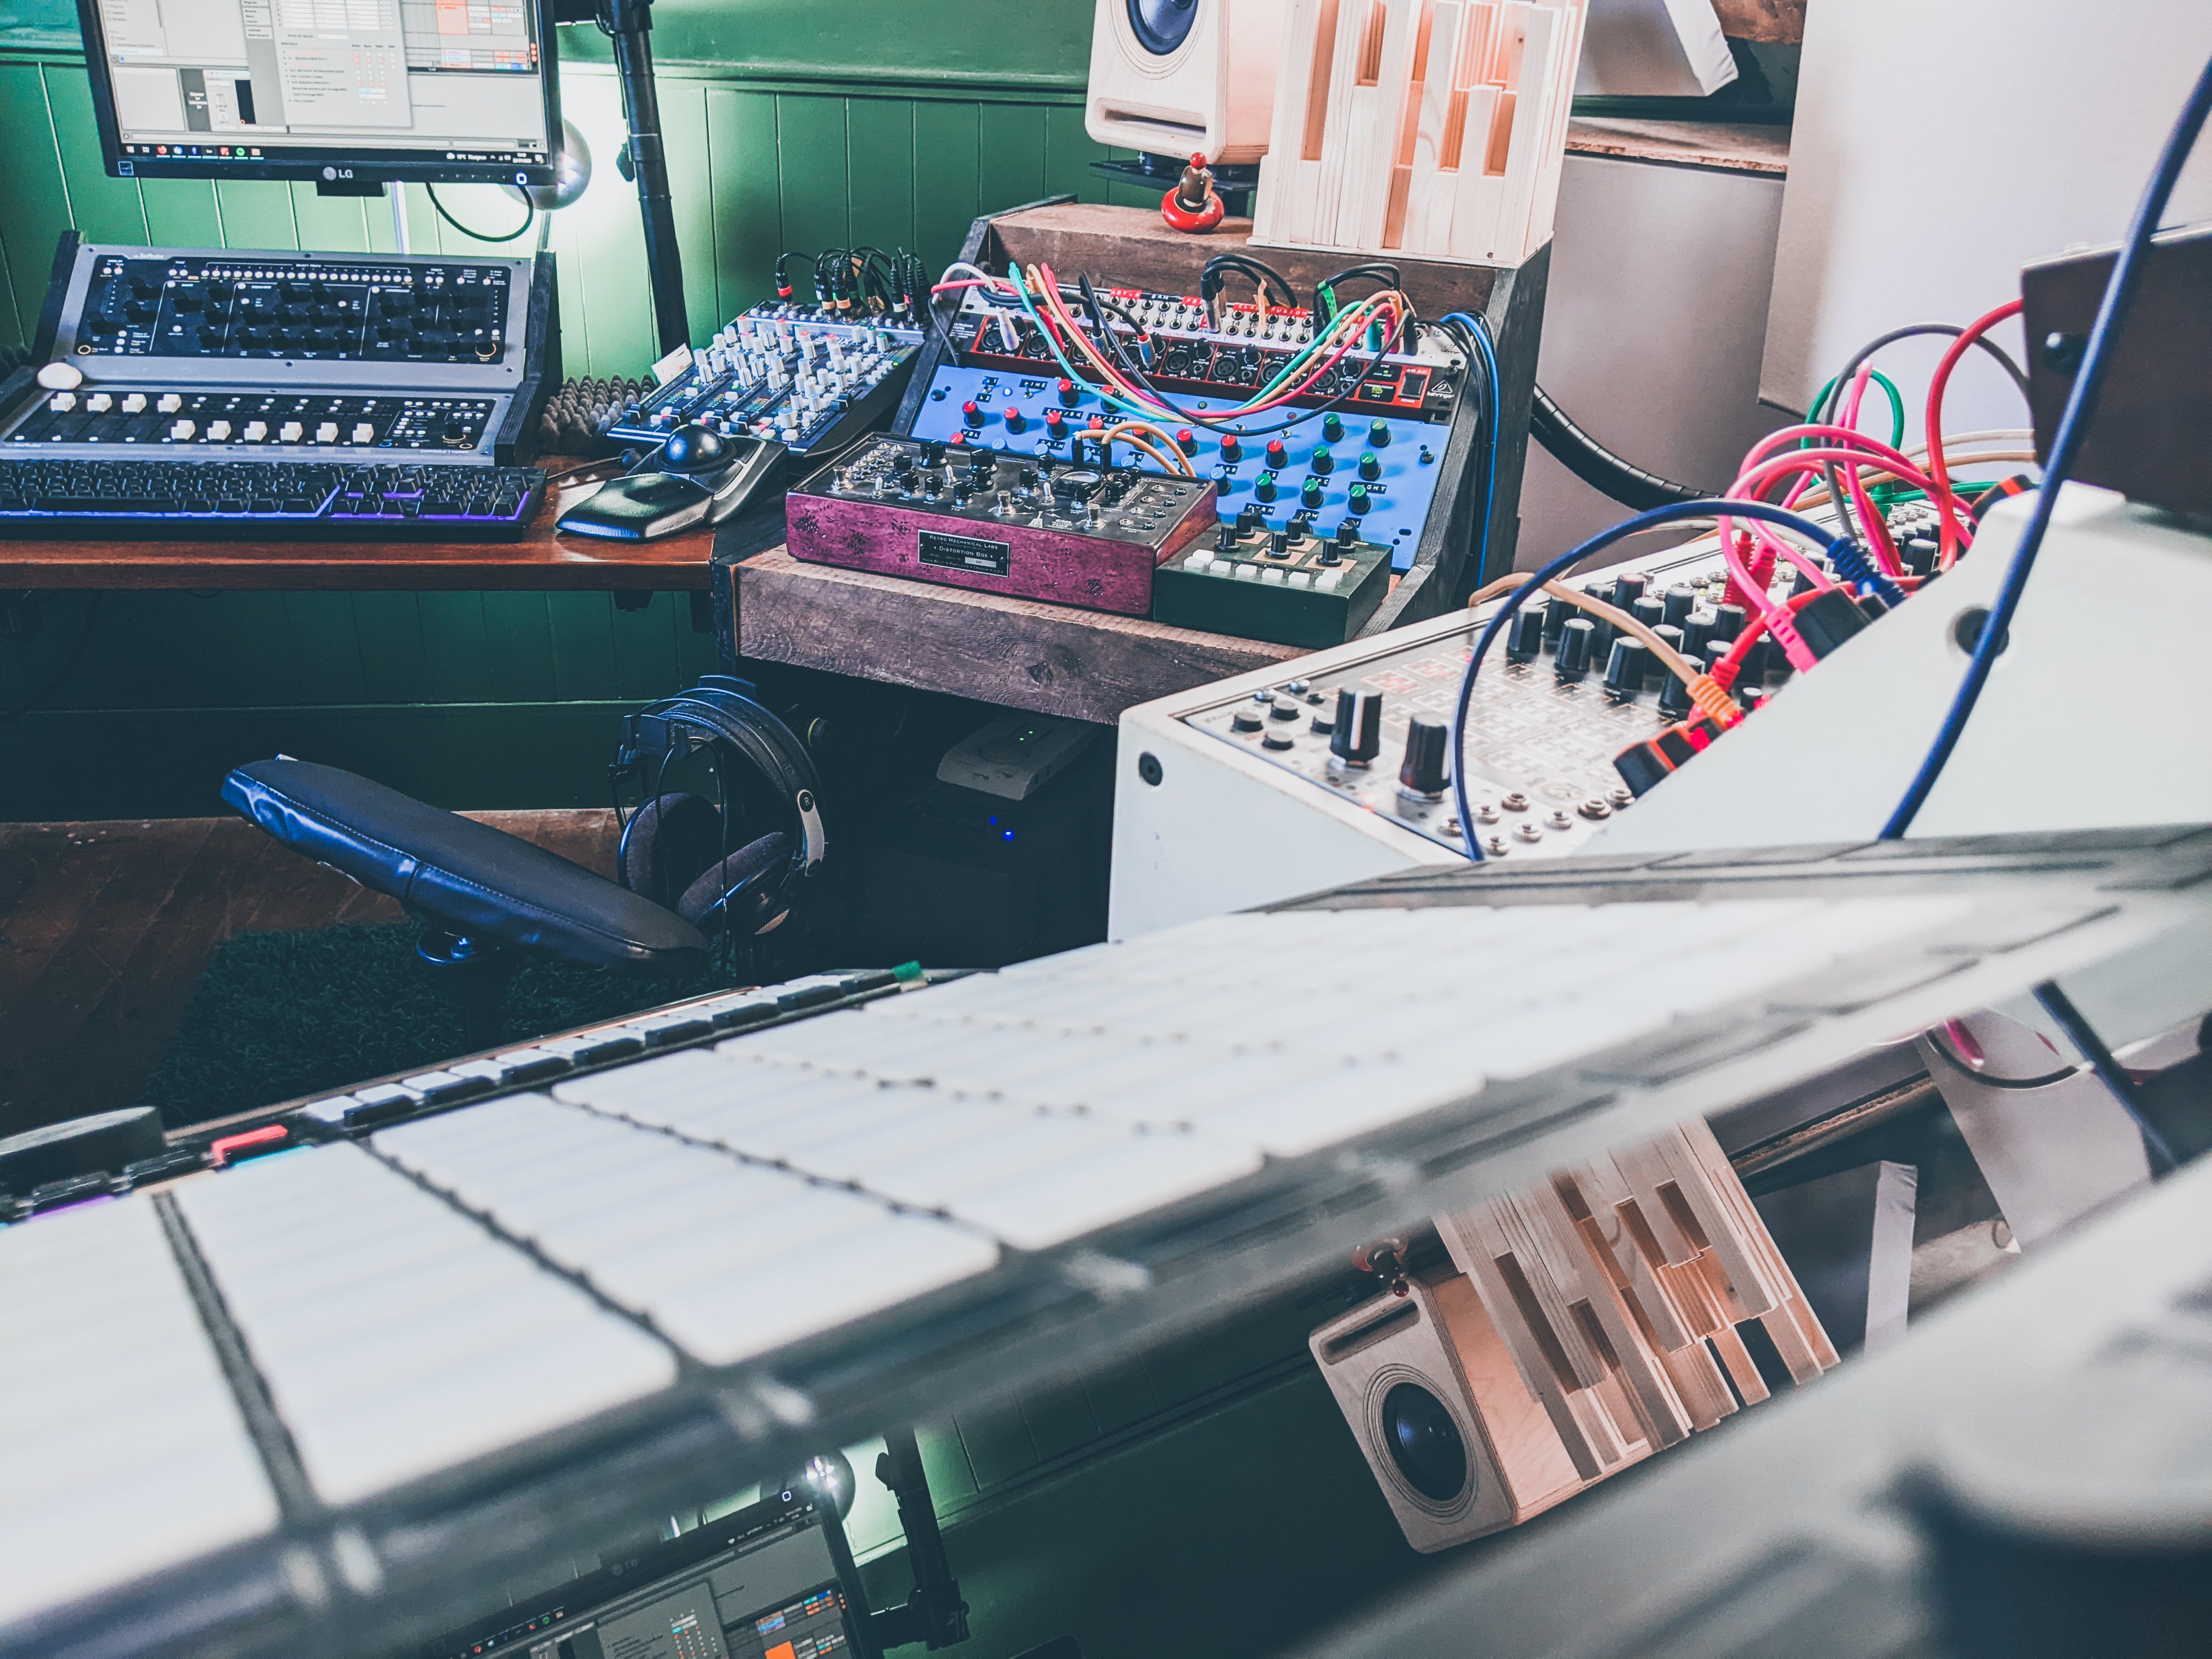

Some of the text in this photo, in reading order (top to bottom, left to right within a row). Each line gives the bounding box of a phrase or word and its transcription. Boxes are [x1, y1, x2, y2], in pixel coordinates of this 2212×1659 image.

[338, 169, 353, 179] LG
[1427, 391, 1454, 399] behringer
[949, 538, 982, 548] MECHANICAL
[939, 546, 974, 556] DISTORTION
[804, 797, 810, 806] R
